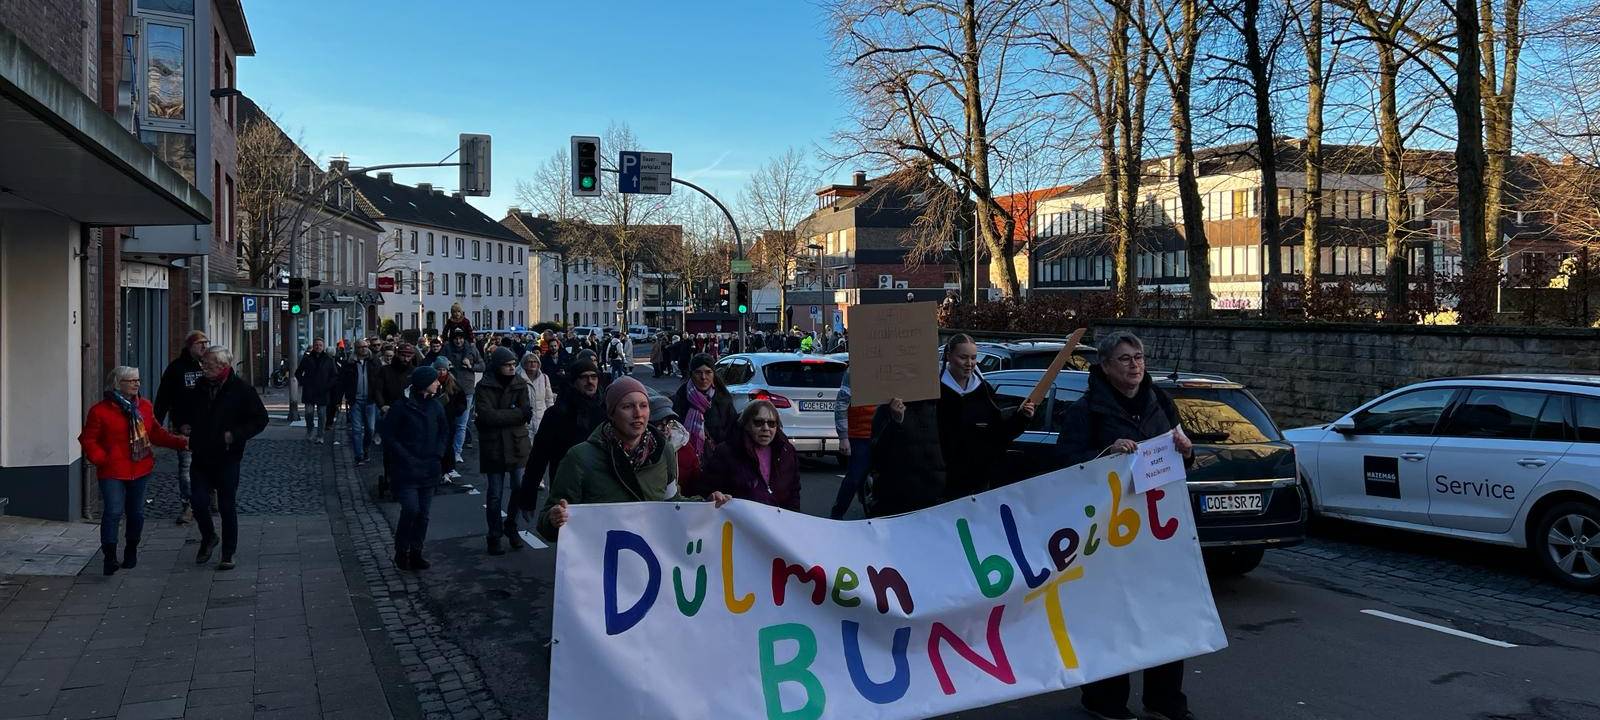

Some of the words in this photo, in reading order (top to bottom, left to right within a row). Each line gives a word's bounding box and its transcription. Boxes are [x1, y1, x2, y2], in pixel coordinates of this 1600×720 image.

[623, 155, 637, 174] P
[246, 298, 255, 311] P
[1150, 456, 1164, 466] statt
[1434, 474, 1515, 500] Service
[1206, 496, 1228, 510] COE
[1234, 495, 1248, 509] SR
[1249, 494, 1262, 508] 72
[603, 520, 915, 636] Dülmen
[955, 470, 1180, 600] bleibt
[758, 565, 1084, 720] BUNT
